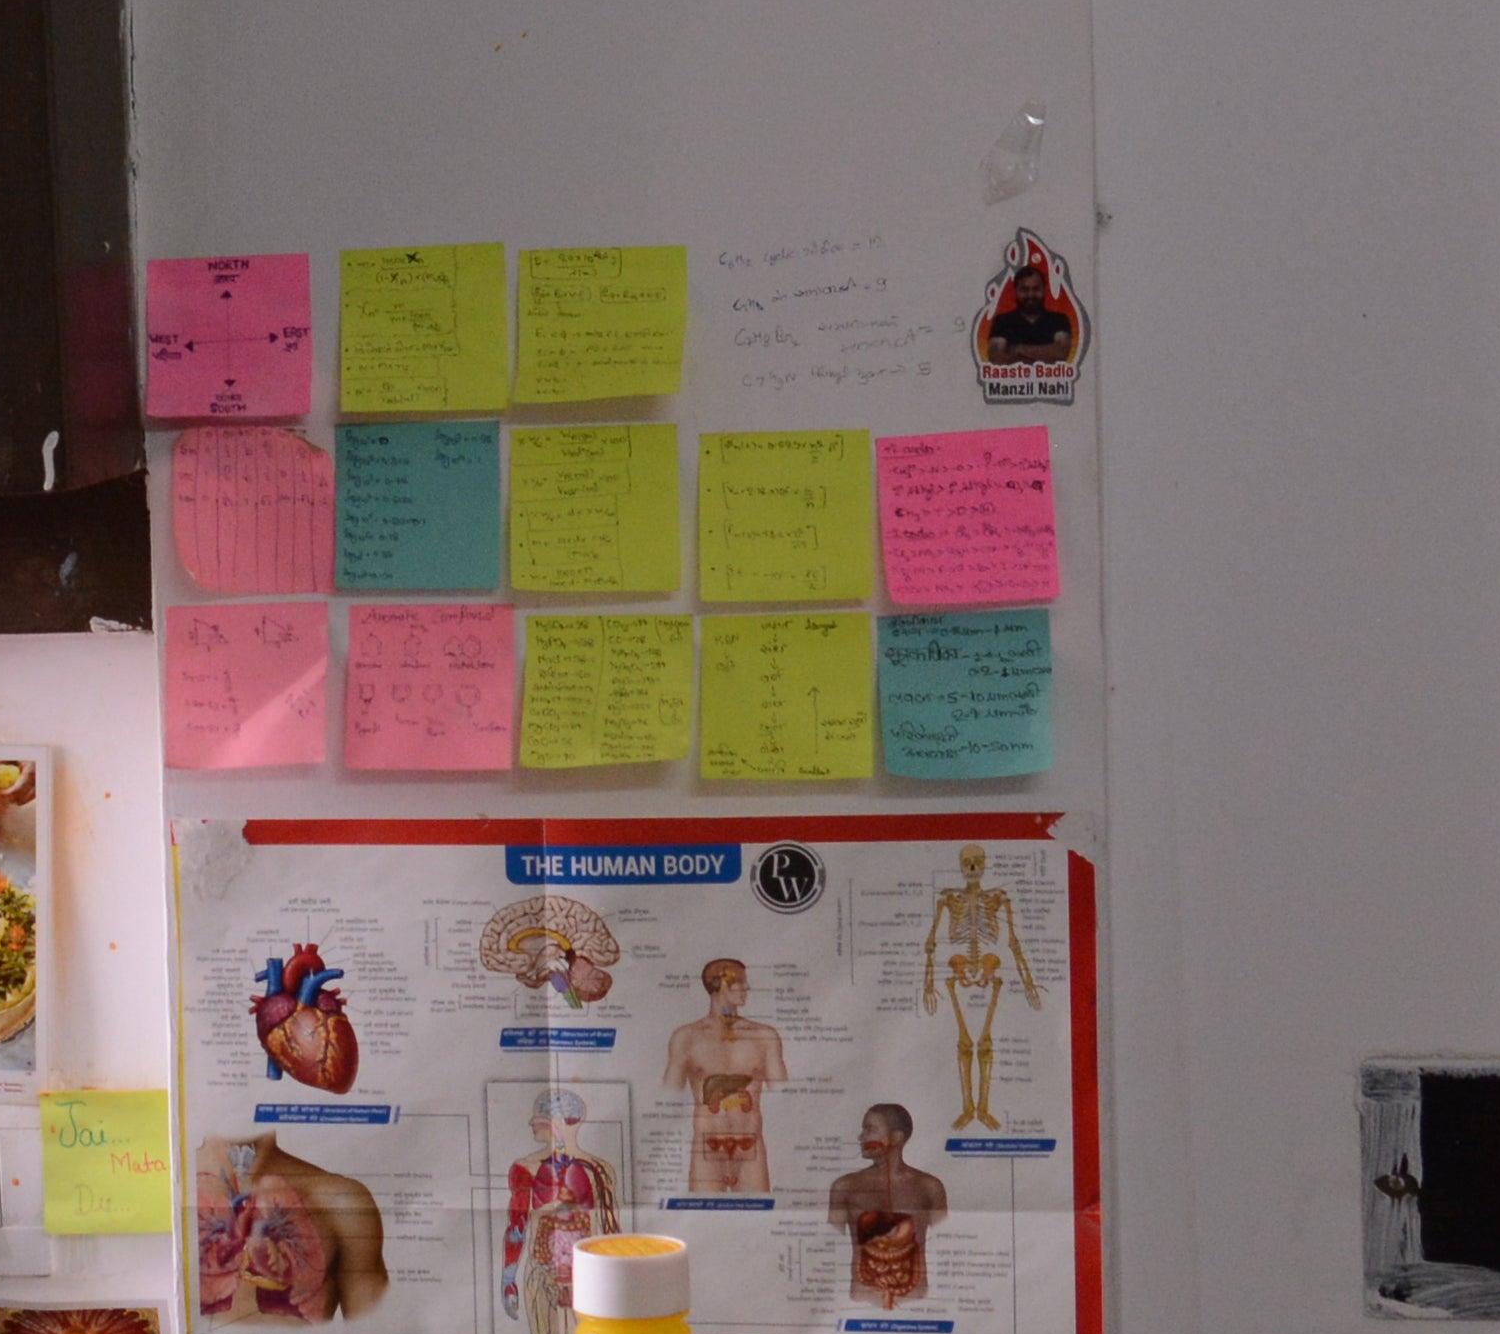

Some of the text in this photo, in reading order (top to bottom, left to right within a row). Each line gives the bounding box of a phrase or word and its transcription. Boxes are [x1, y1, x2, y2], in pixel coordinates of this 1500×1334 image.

[208, 260, 249, 271] NORTH
[149, 326, 310, 345] WEST EAST
[982, 365, 1031, 379] Raaste
[988, 381, 1069, 396] Manzil Nahi
[209, 402, 247, 414] SOUTH
[521, 854, 726, 877] THE HUMAN BODY
[110, 1150, 167, 1175] Mata
